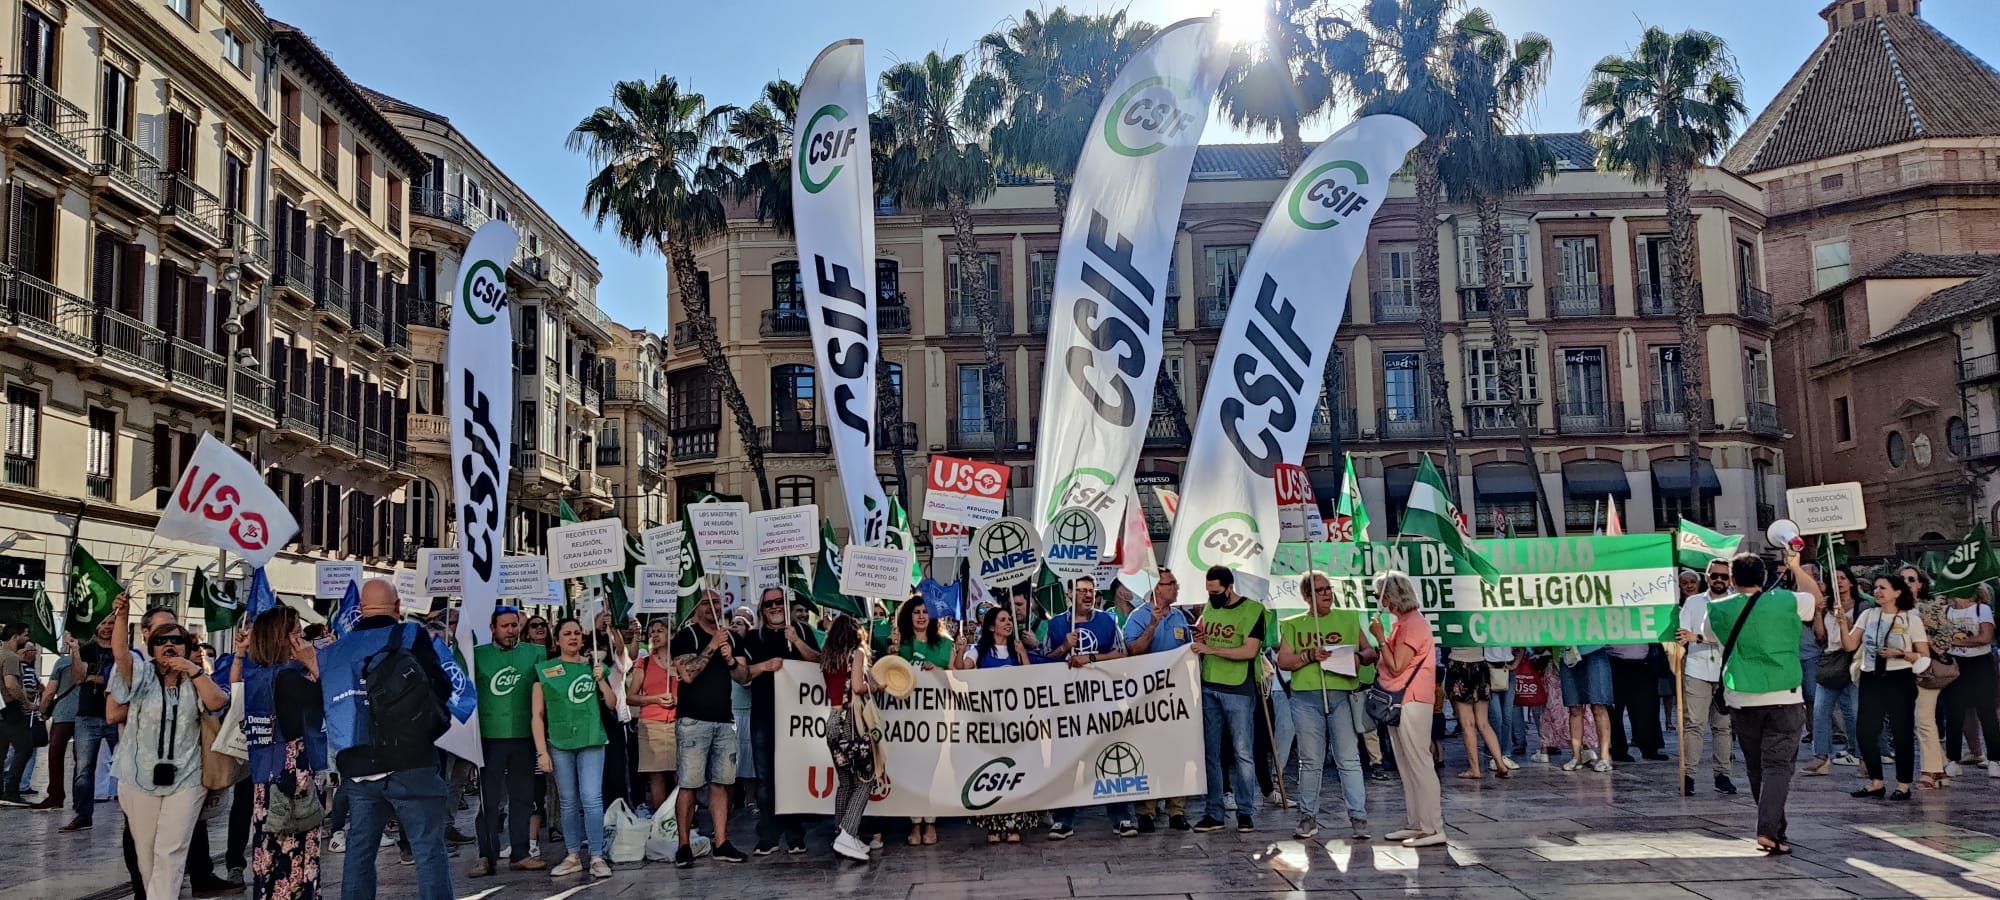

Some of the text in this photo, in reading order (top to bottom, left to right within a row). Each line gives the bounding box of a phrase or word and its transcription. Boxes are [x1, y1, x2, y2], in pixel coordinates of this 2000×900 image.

[808, 127, 857, 166] CSIF
[1306, 178, 1368, 218] CSIF
[1065, 207, 1155, 428] CSIF
[1219, 271, 1312, 479] CSIF
[462, 367, 501, 583] CSIF
[934, 459, 1002, 495] USO
[179, 464, 269, 551] USO
[565, 529, 597, 539] RECORTES
[1203, 527, 1265, 561] CSIF
[562, 551, 582, 560] GRAN
[583, 549, 603, 558] DAÑO
[570, 558, 608, 569] EDUCACIÓN
[980, 548, 1037, 576] ANPE
[1048, 543, 1098, 560] ANPE
[1422, 543, 1455, 575] DE
[996, 572, 1024, 583] MÁLAGA
[1421, 578, 1455, 608] DE
[1620, 574, 1677, 607] MÁLAGA
[1204, 621, 1236, 639] USO
[1468, 607, 1657, 644] COMPUTABLE
[496, 672, 521, 687] CSIF
[1023, 685, 1059, 710] DEL
[1064, 679, 1138, 705] EMPLEO
[1143, 668, 1176, 695] DEL
[936, 721, 960, 743] DE
[966, 715, 1052, 744] RELIGIÓN
[1057, 715, 1081, 738] EN
[1086, 692, 1190, 736] ANDALUCÍA
[1092, 775, 1150, 796] ANPE
